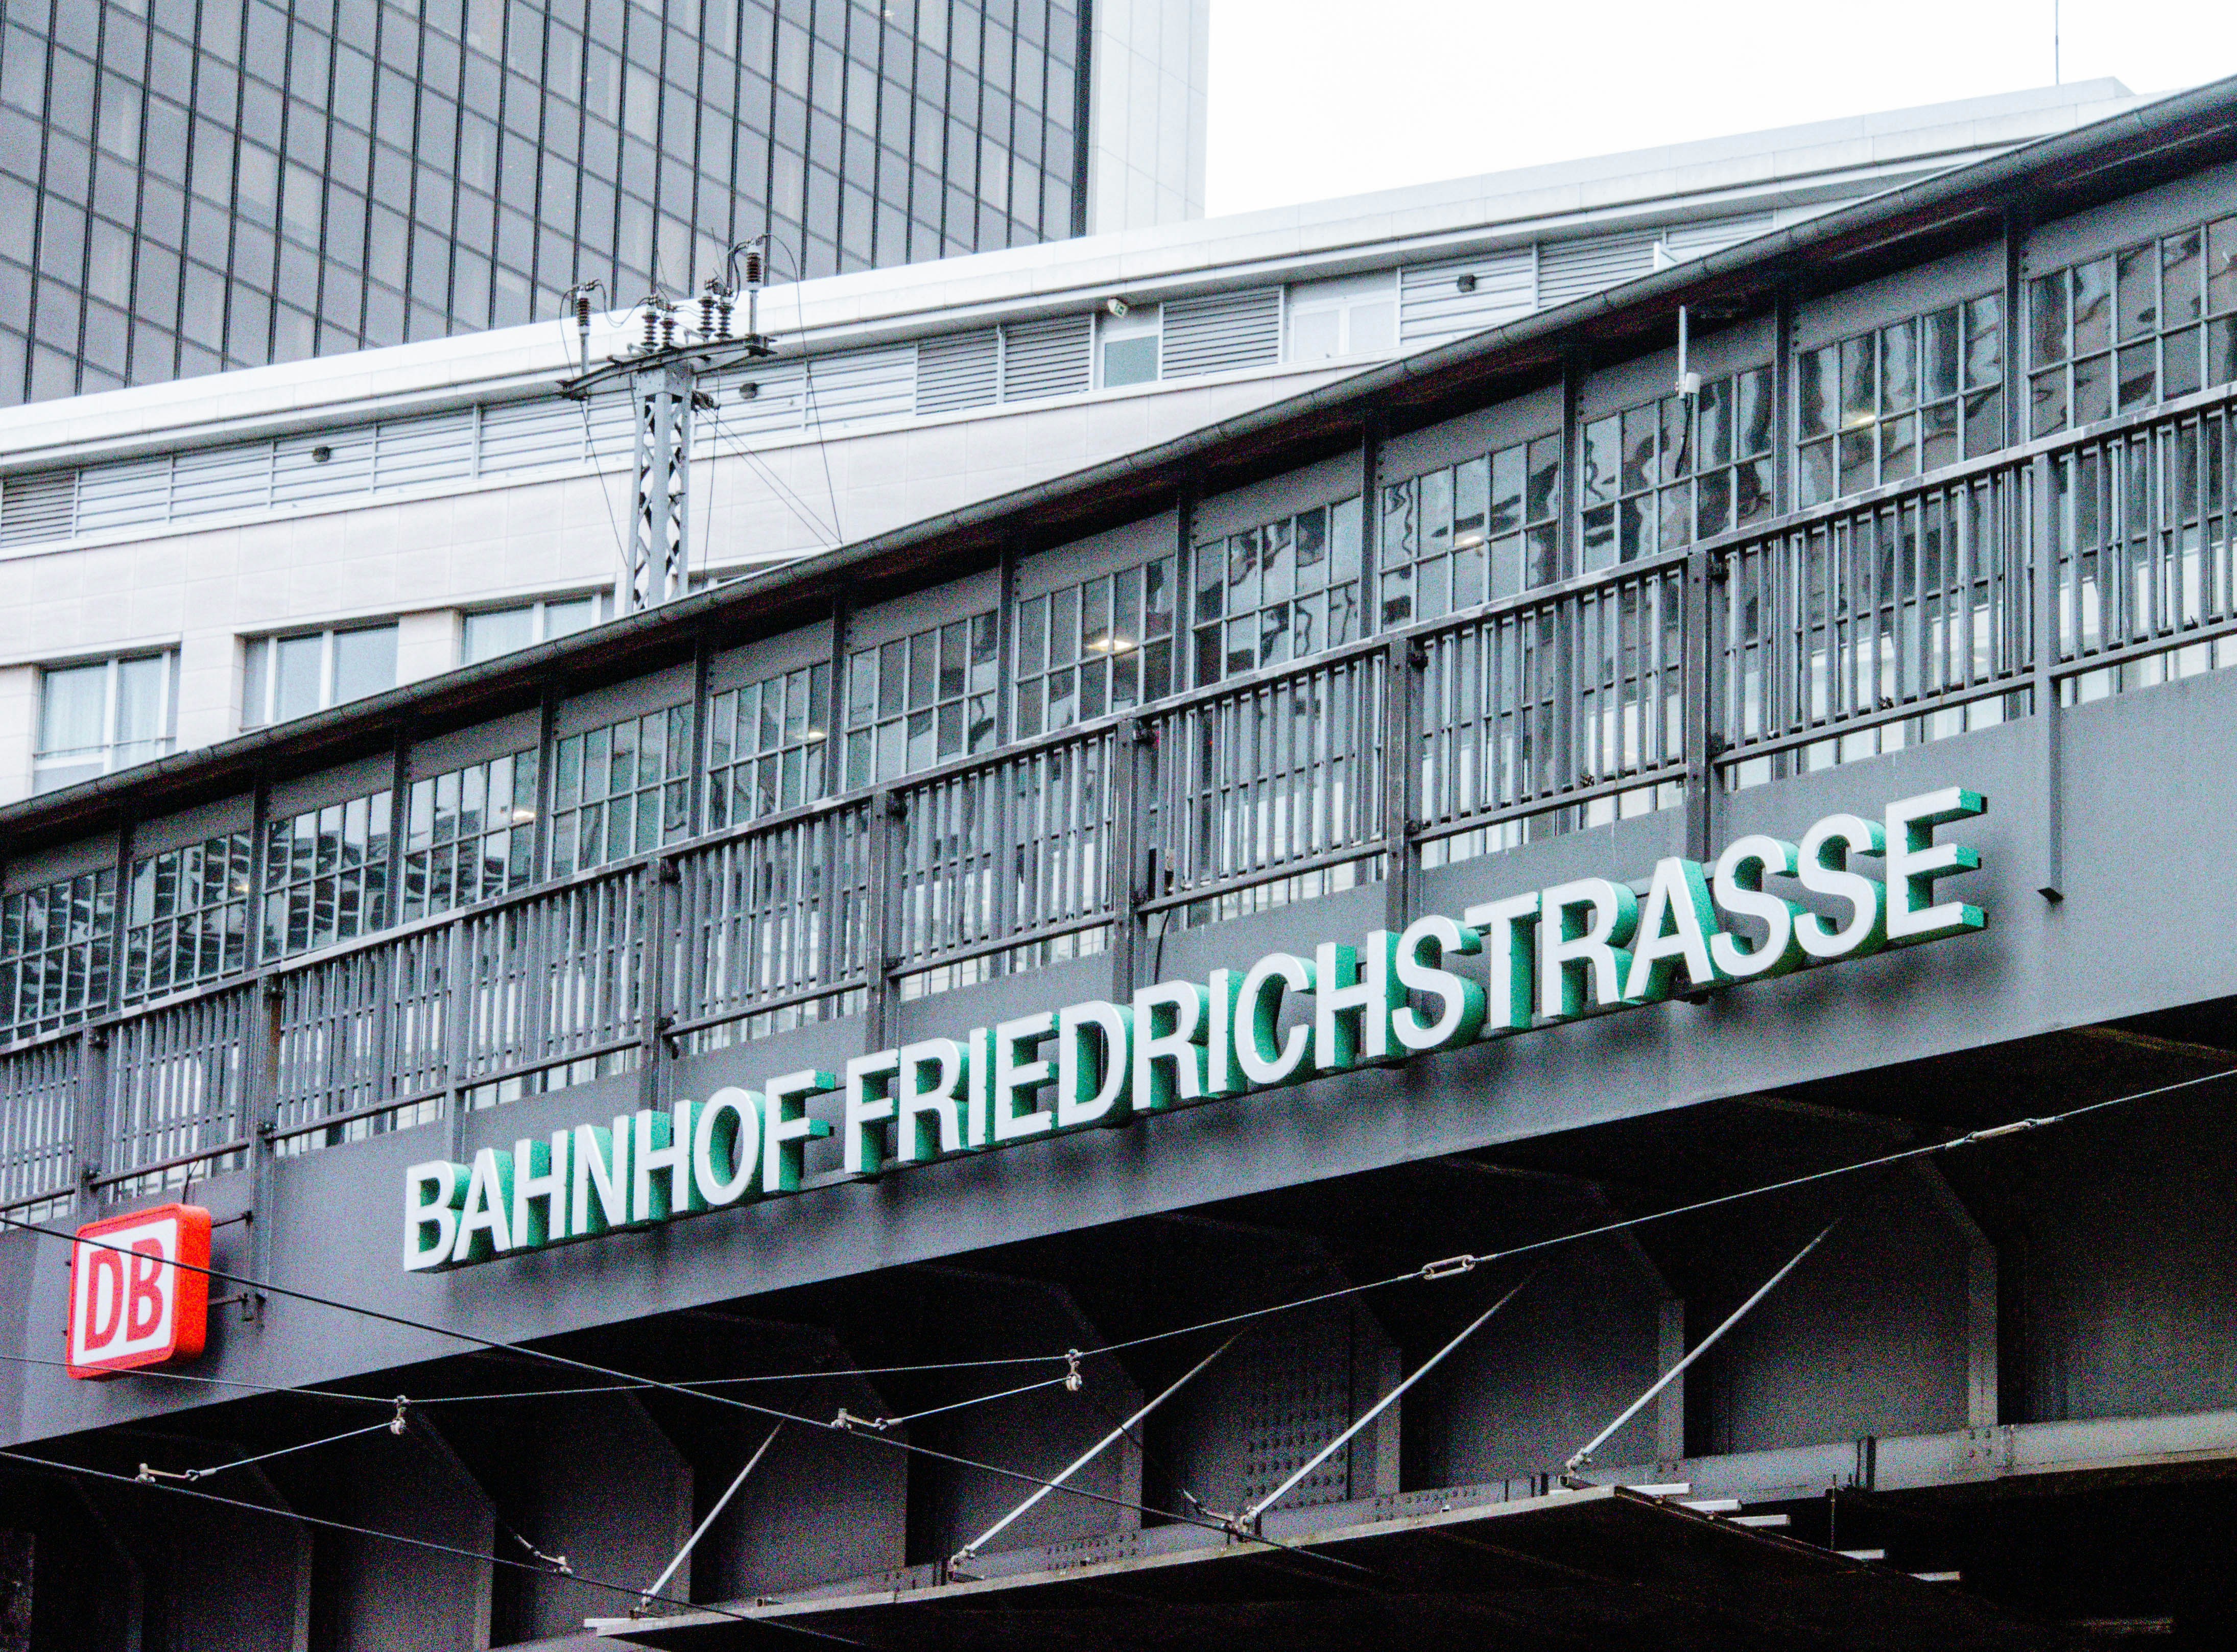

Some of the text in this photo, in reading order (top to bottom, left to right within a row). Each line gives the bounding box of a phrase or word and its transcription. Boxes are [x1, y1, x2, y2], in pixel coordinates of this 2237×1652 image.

[404, 786, 1984, 1272] BAHNHOF FRIEDRICHSTRASSE
[83, 1237, 164, 1352] DB
